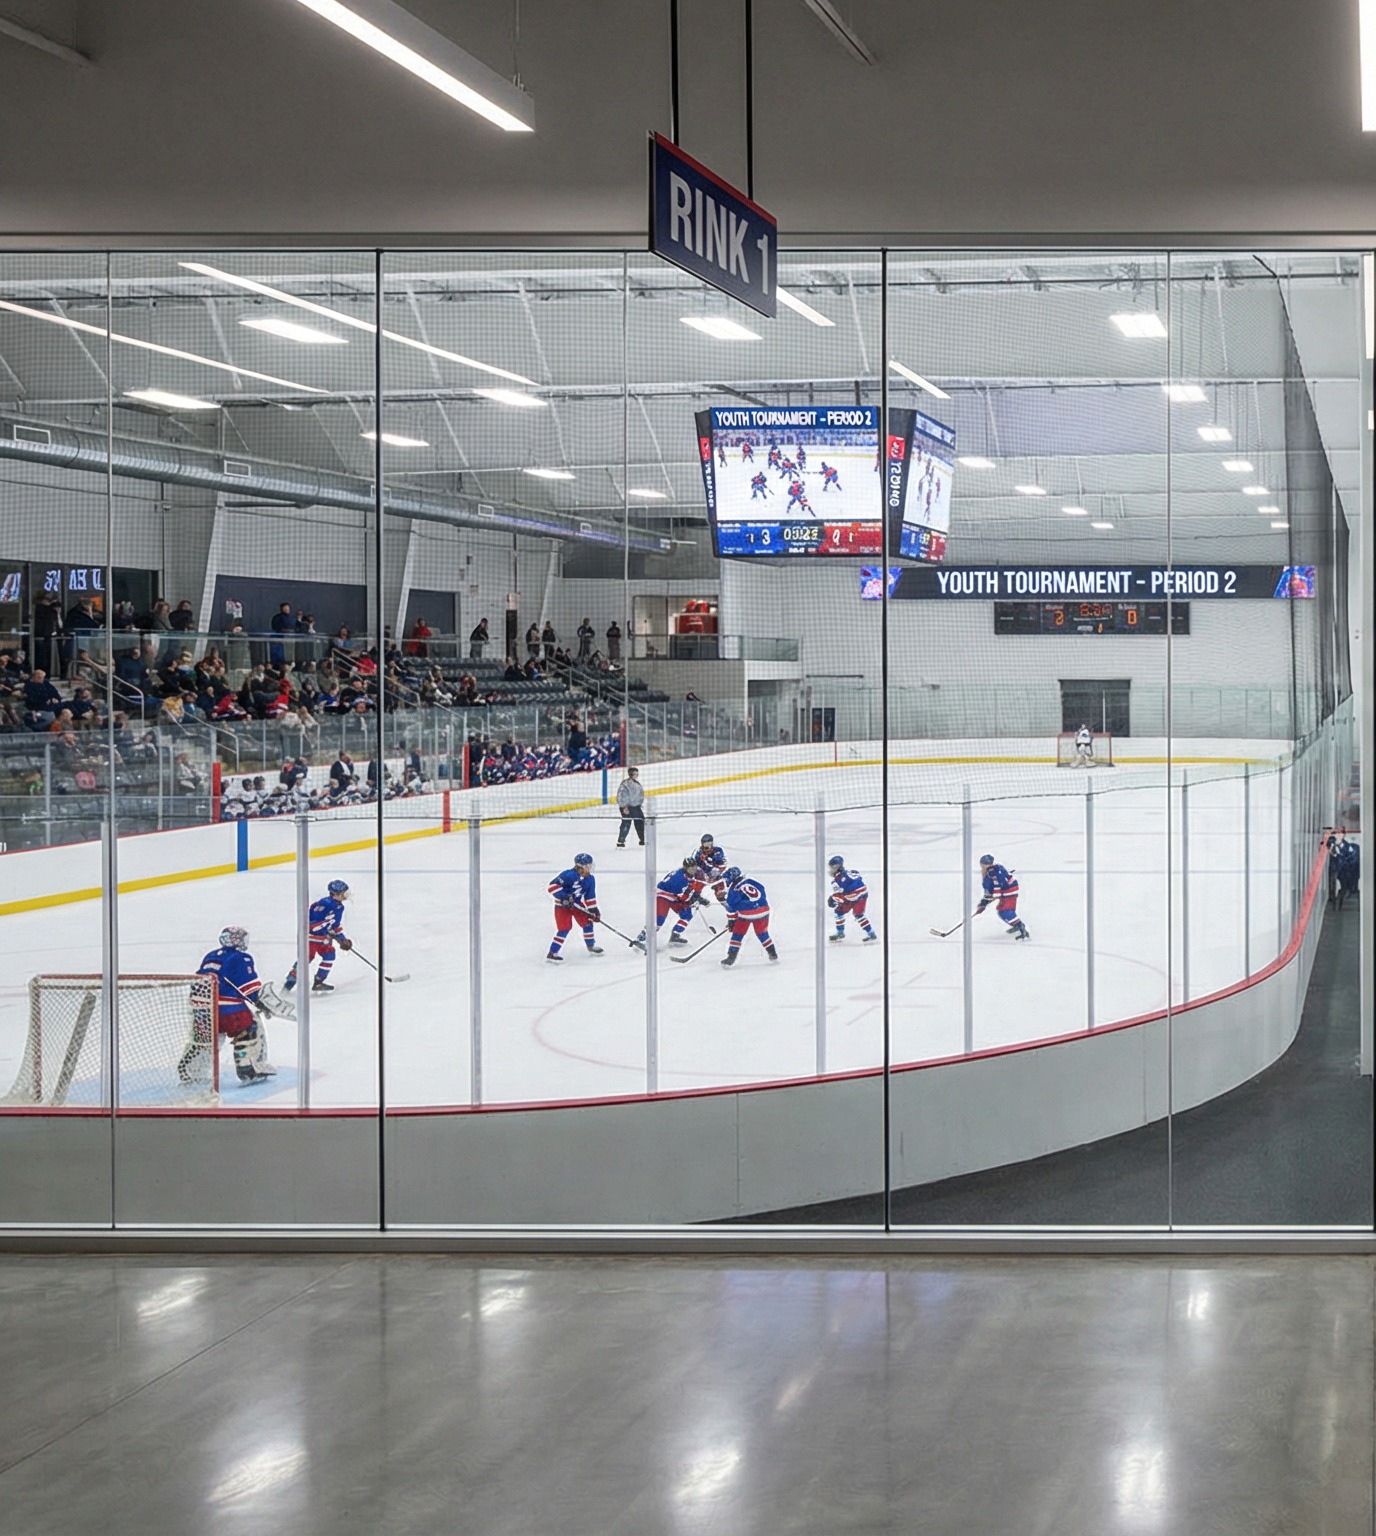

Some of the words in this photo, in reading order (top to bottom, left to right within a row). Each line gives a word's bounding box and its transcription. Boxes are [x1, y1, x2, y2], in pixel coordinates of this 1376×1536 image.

[670, 171, 750, 284] RINK
[757, 233, 769, 295] 1
[715, 411, 750, 426] YOUTH
[865, 411, 872, 425] 2
[936, 570, 999, 594] YOUTH
[1003, 570, 1131, 594] TOURNAMENT
[1151, 570, 1218, 594] PERIOD
[1225, 570, 1237, 594] 2
